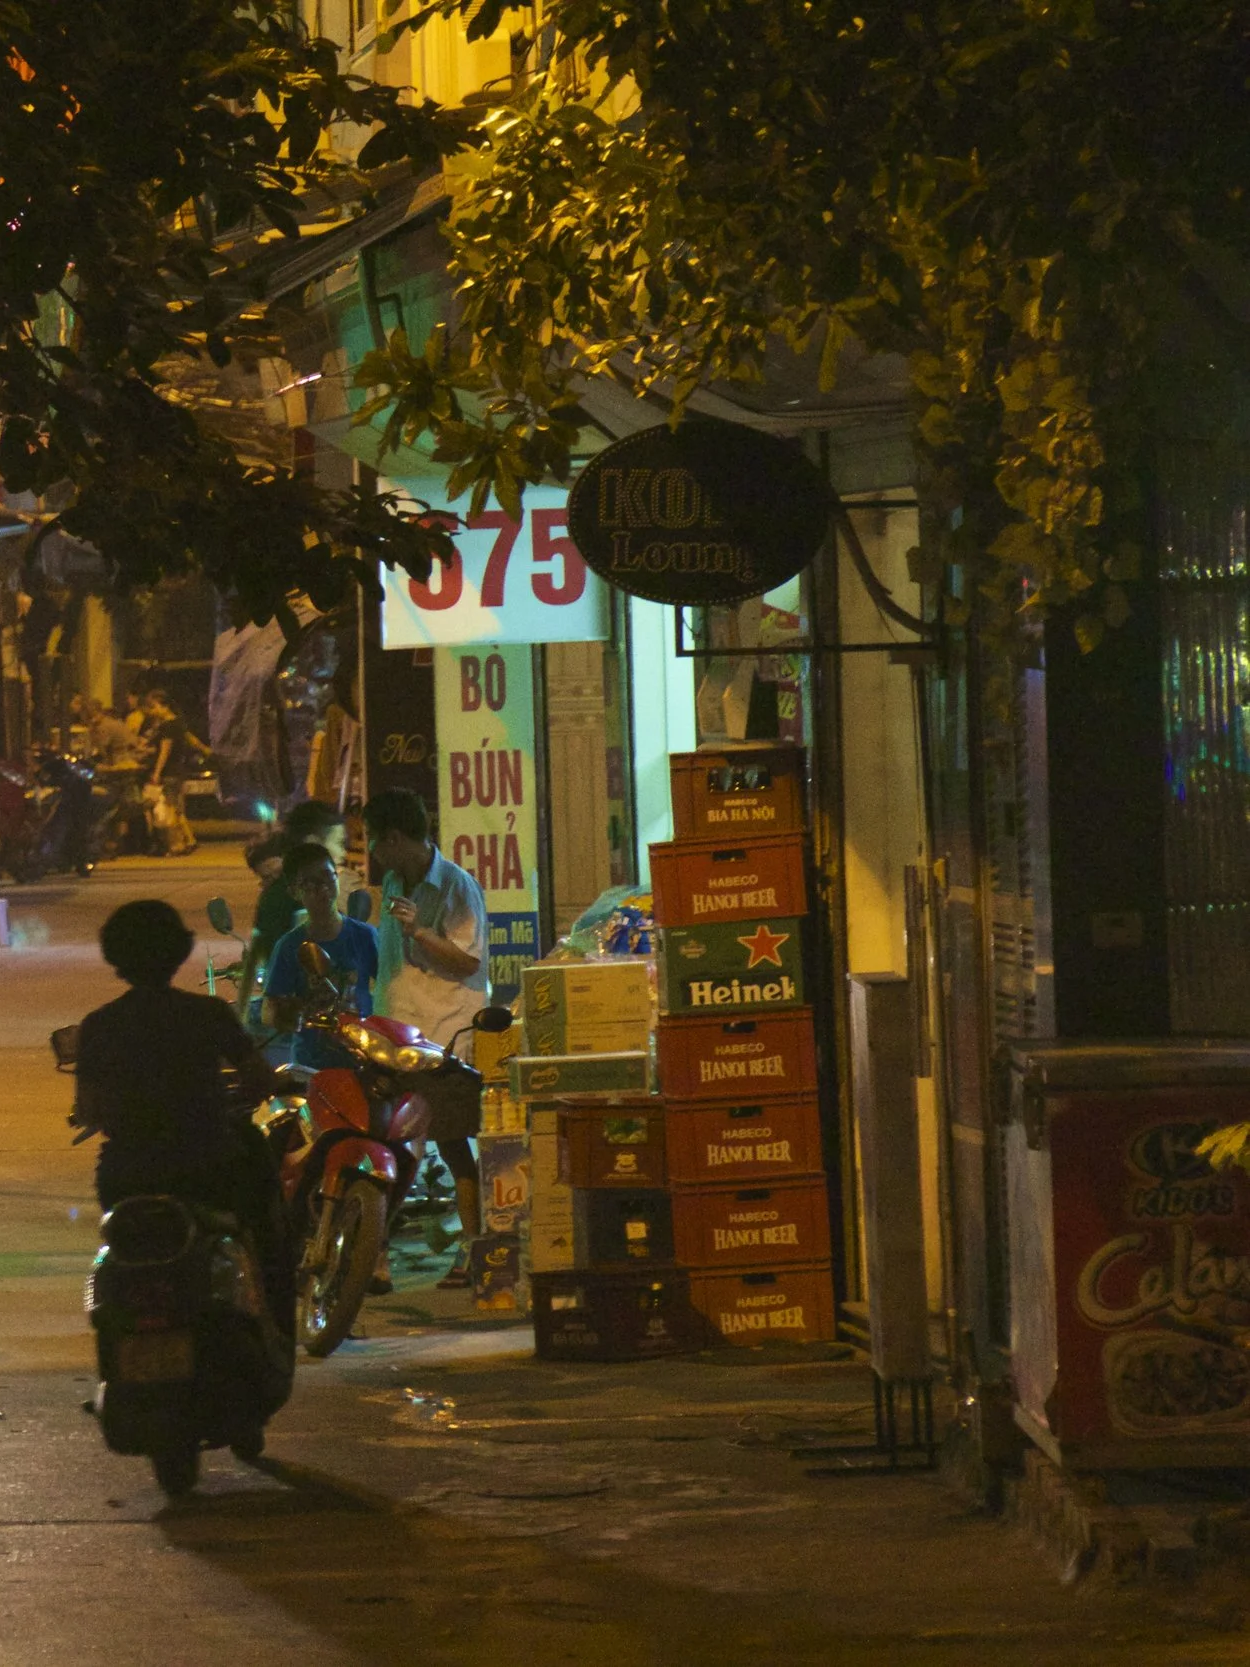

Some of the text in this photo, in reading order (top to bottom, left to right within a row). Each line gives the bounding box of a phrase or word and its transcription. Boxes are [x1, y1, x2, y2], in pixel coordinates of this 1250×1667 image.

[449, 737, 524, 808] BÚN
[452, 811, 525, 890] CHẢ
[709, 874, 758, 889] HABECO
[693, 887, 779, 915] HANOI BEER
[487, 921, 508, 945] im
[715, 1042, 765, 1056] HABECO
[700, 1055, 786, 1083] HANOI BEER
[722, 1127, 772, 1141] HABECO
[707, 1140, 793, 1167] HANOI BEER
[729, 1210, 779, 1224] HABECO
[714, 1223, 800, 1251] HANOI BEER
[736, 1294, 786, 1308] HABECO
[720, 1305, 807, 1335] HANOI BEER
